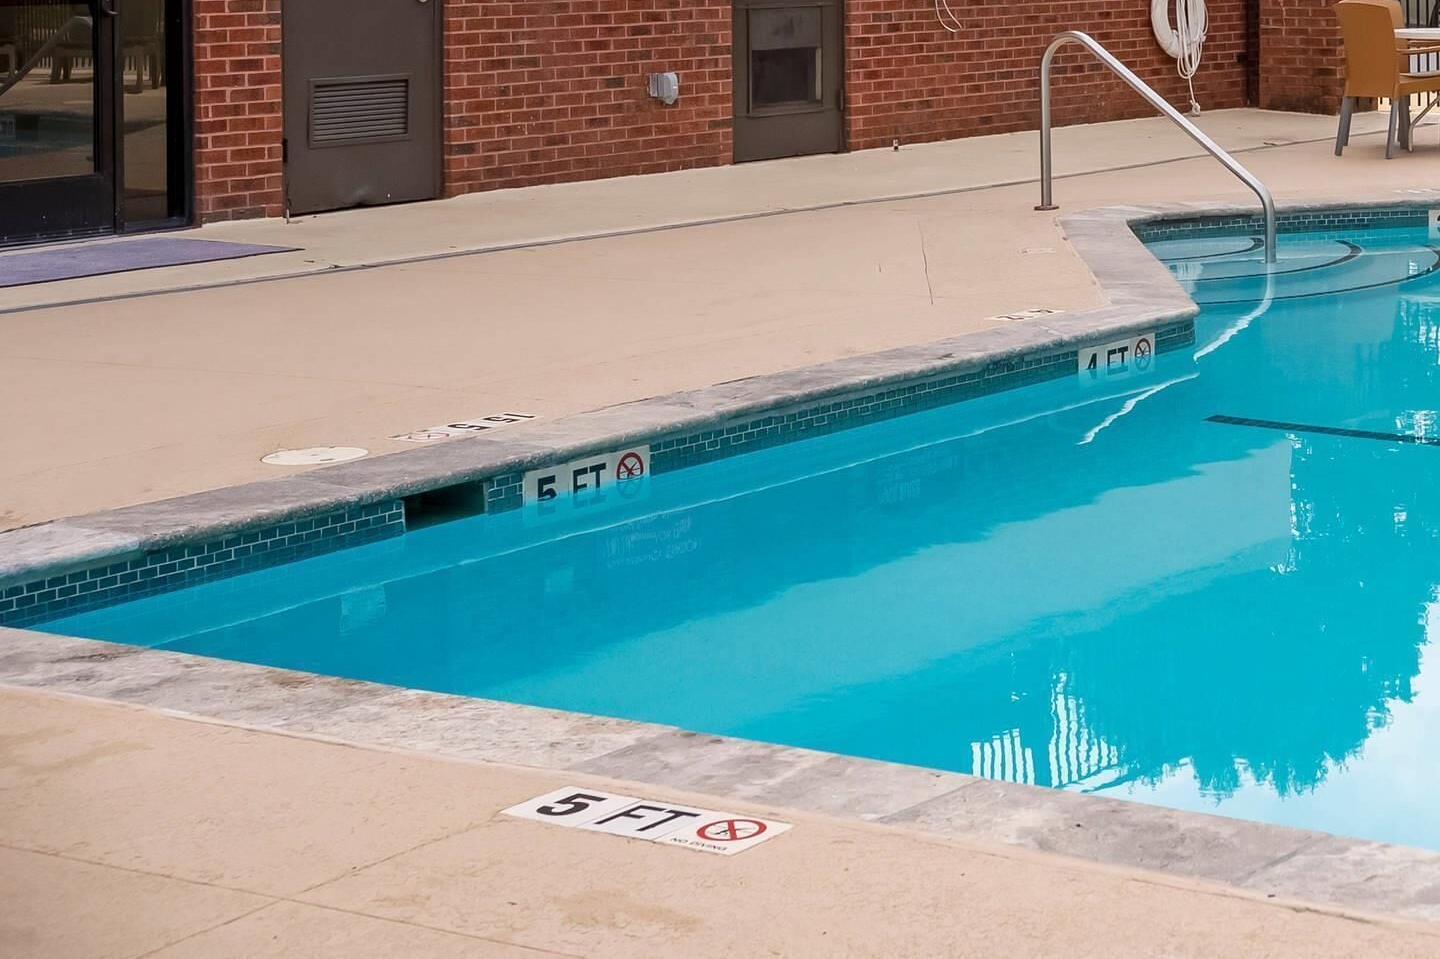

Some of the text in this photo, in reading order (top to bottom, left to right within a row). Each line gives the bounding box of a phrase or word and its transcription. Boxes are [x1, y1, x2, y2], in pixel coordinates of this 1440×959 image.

[537, 462, 607, 502] 5 FT
[536, 793, 701, 832] 5 FT
